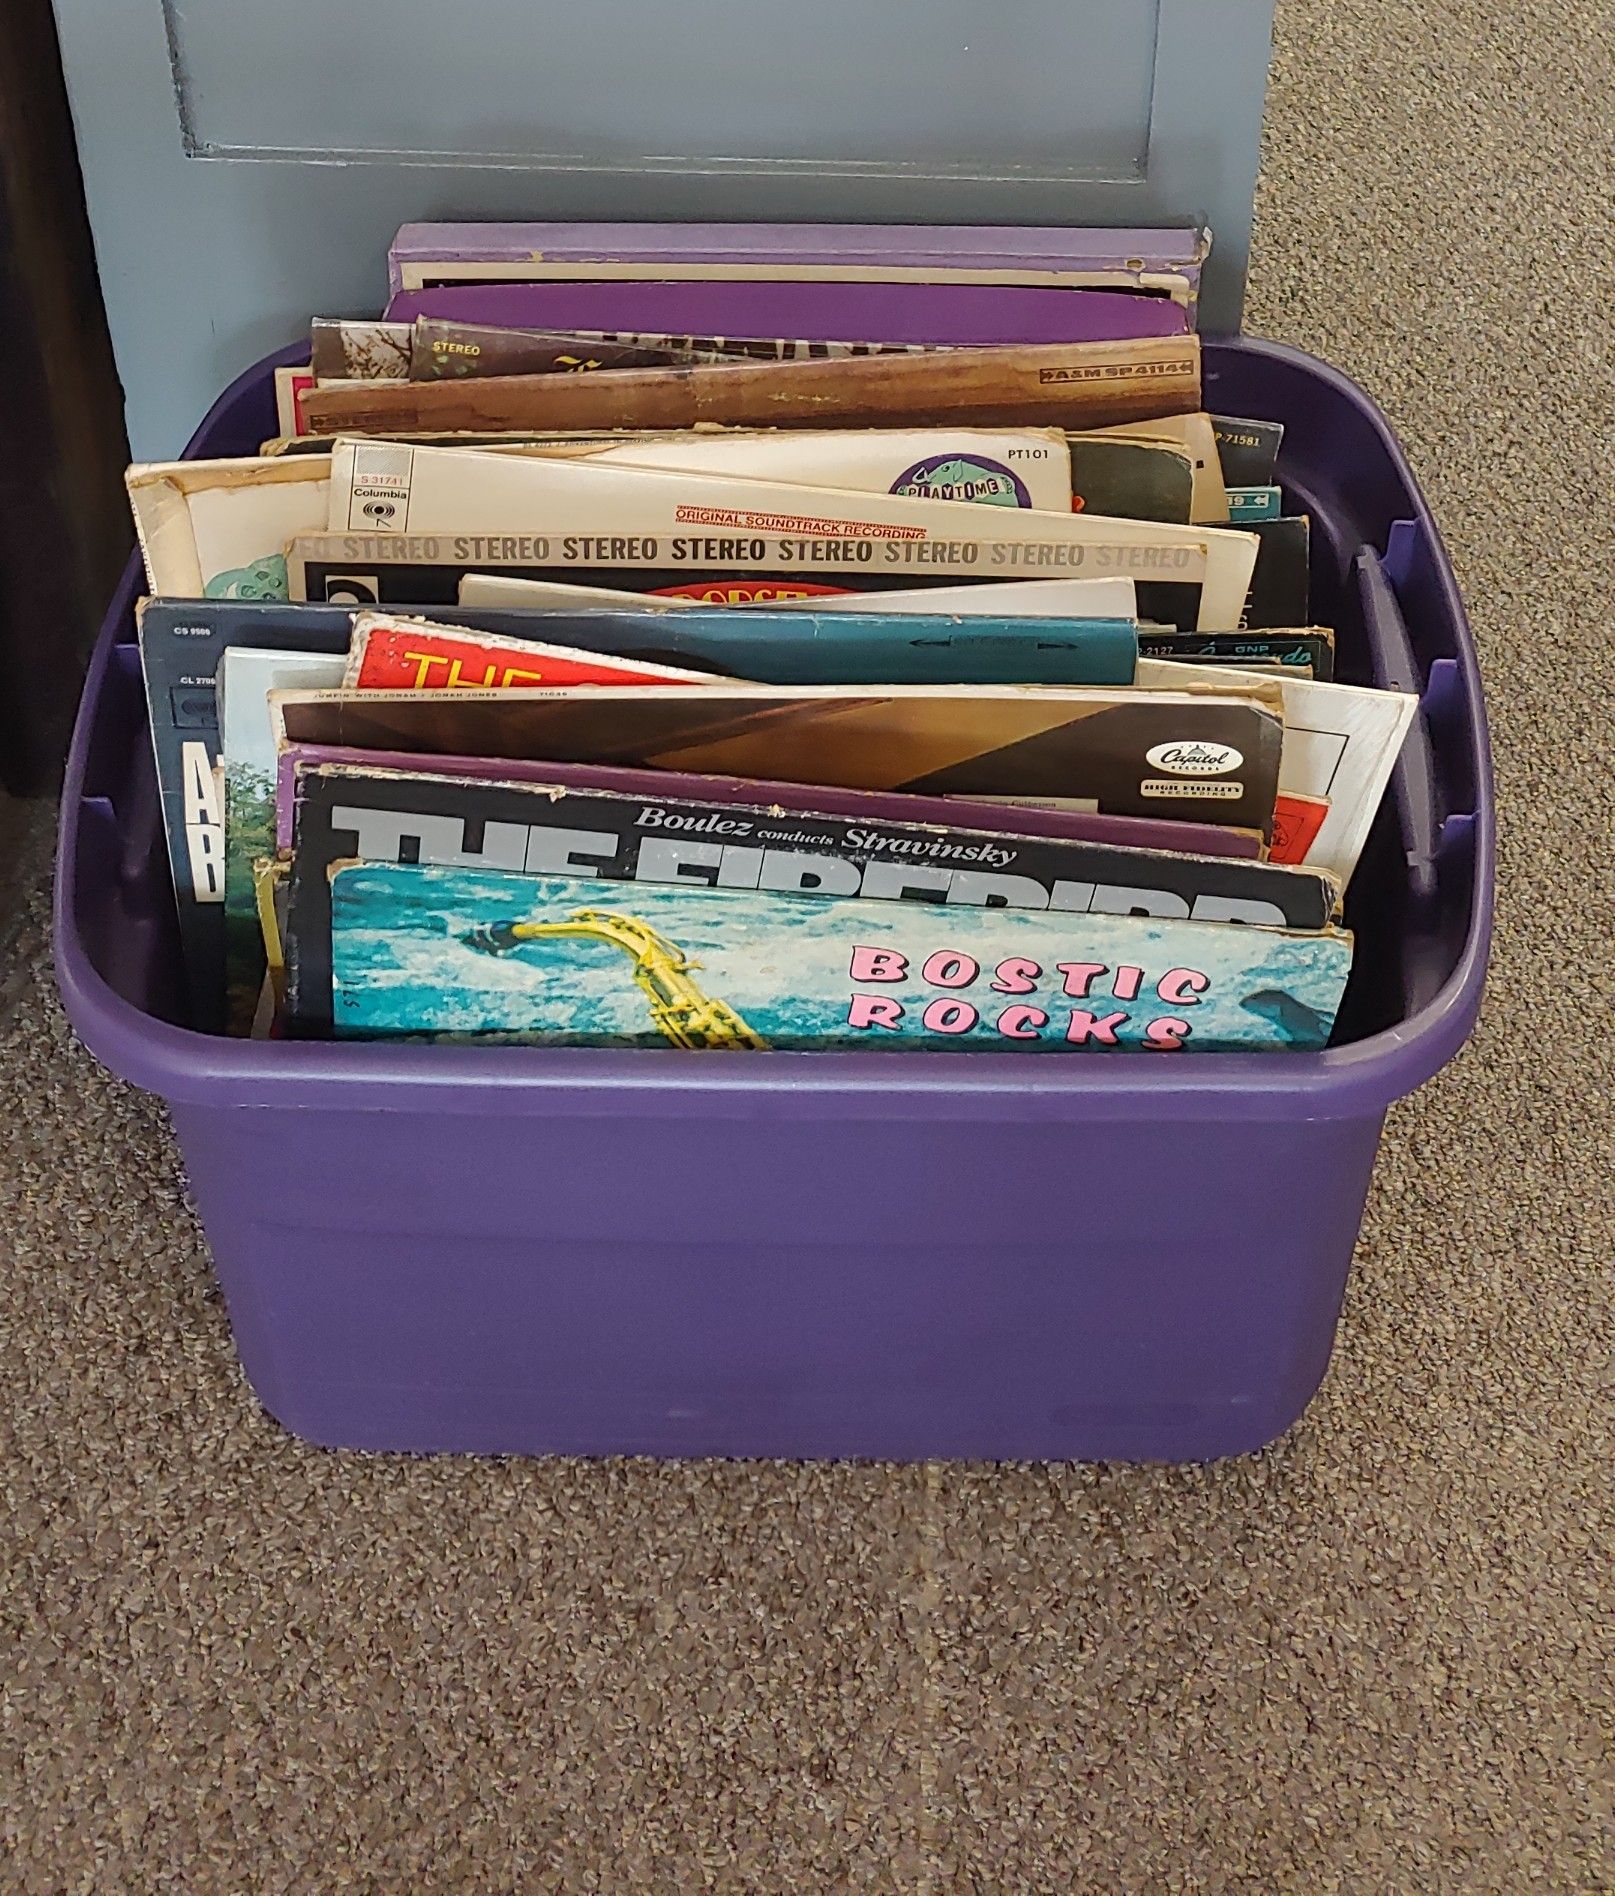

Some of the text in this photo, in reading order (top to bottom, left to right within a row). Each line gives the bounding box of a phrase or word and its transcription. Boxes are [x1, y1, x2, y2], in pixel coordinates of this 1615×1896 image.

[432, 340, 481, 356] STEREO
[1104, 367, 1133, 377] SP
[1135, 363, 1178, 375] 4114
[1007, 449, 1049, 460] PT101
[361, 475, 369, 485] S
[353, 487, 407, 500] Columbia
[908, 479, 999, 500] PLAYTIME
[675, 509, 926, 540] ORIGINAL SOUNDTRACK RECORDING
[343, 537, 440, 560] STEREO
[453, 537, 550, 560] STEREO
[562, 537, 658, 561] STEREO
[671, 538, 766, 561] STEREO
[778, 539, 873, 562] STEREO
[884, 541, 979, 564] STEREO
[990, 543, 1085, 567] STEREO
[1095, 545, 1190, 568] STEREO
[173, 627, 189, 635] CS
[1235, 645, 1269, 653] GNP
[180, 676, 195, 685] CL
[1160, 748, 1230, 766] Capitol
[633, 806, 1018, 868] Boulez conducts Stravinsky
[850, 945, 1211, 1006] BOSTIC
[847, 993, 1193, 1050] ROCKS
